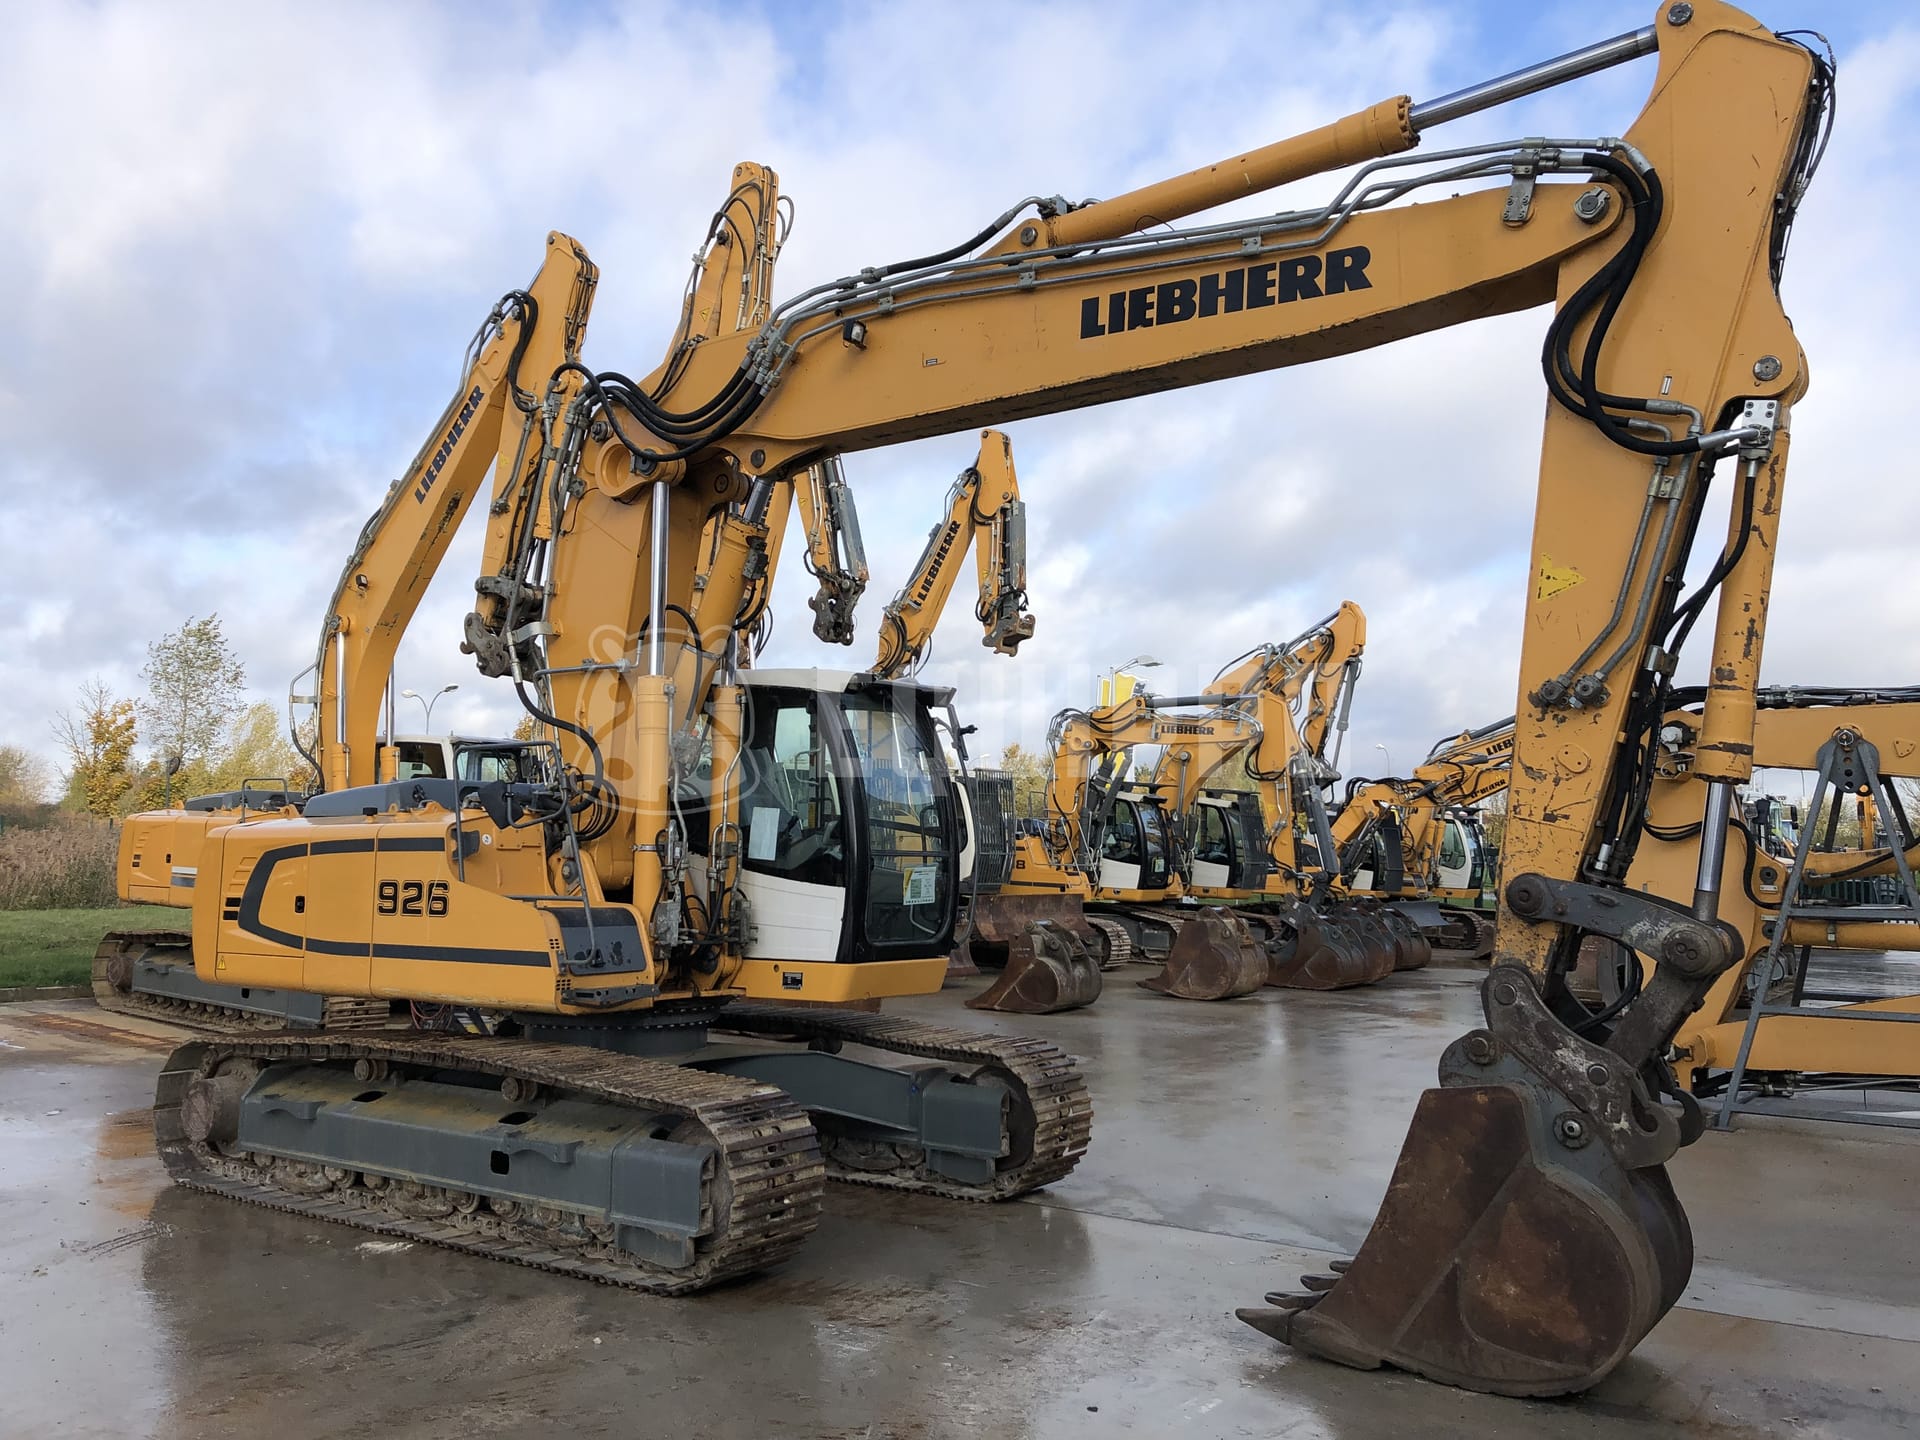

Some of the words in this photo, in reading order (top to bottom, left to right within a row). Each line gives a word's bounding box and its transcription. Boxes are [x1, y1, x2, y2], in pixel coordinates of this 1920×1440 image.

[1080, 245, 1373, 339] LIEBHERR
[414, 385, 485, 504] LIEBHERR
[917, 520, 961, 601] LIEBHERR
[1161, 725, 1214, 735] LIEBHERR
[377, 880, 449, 917] 926
